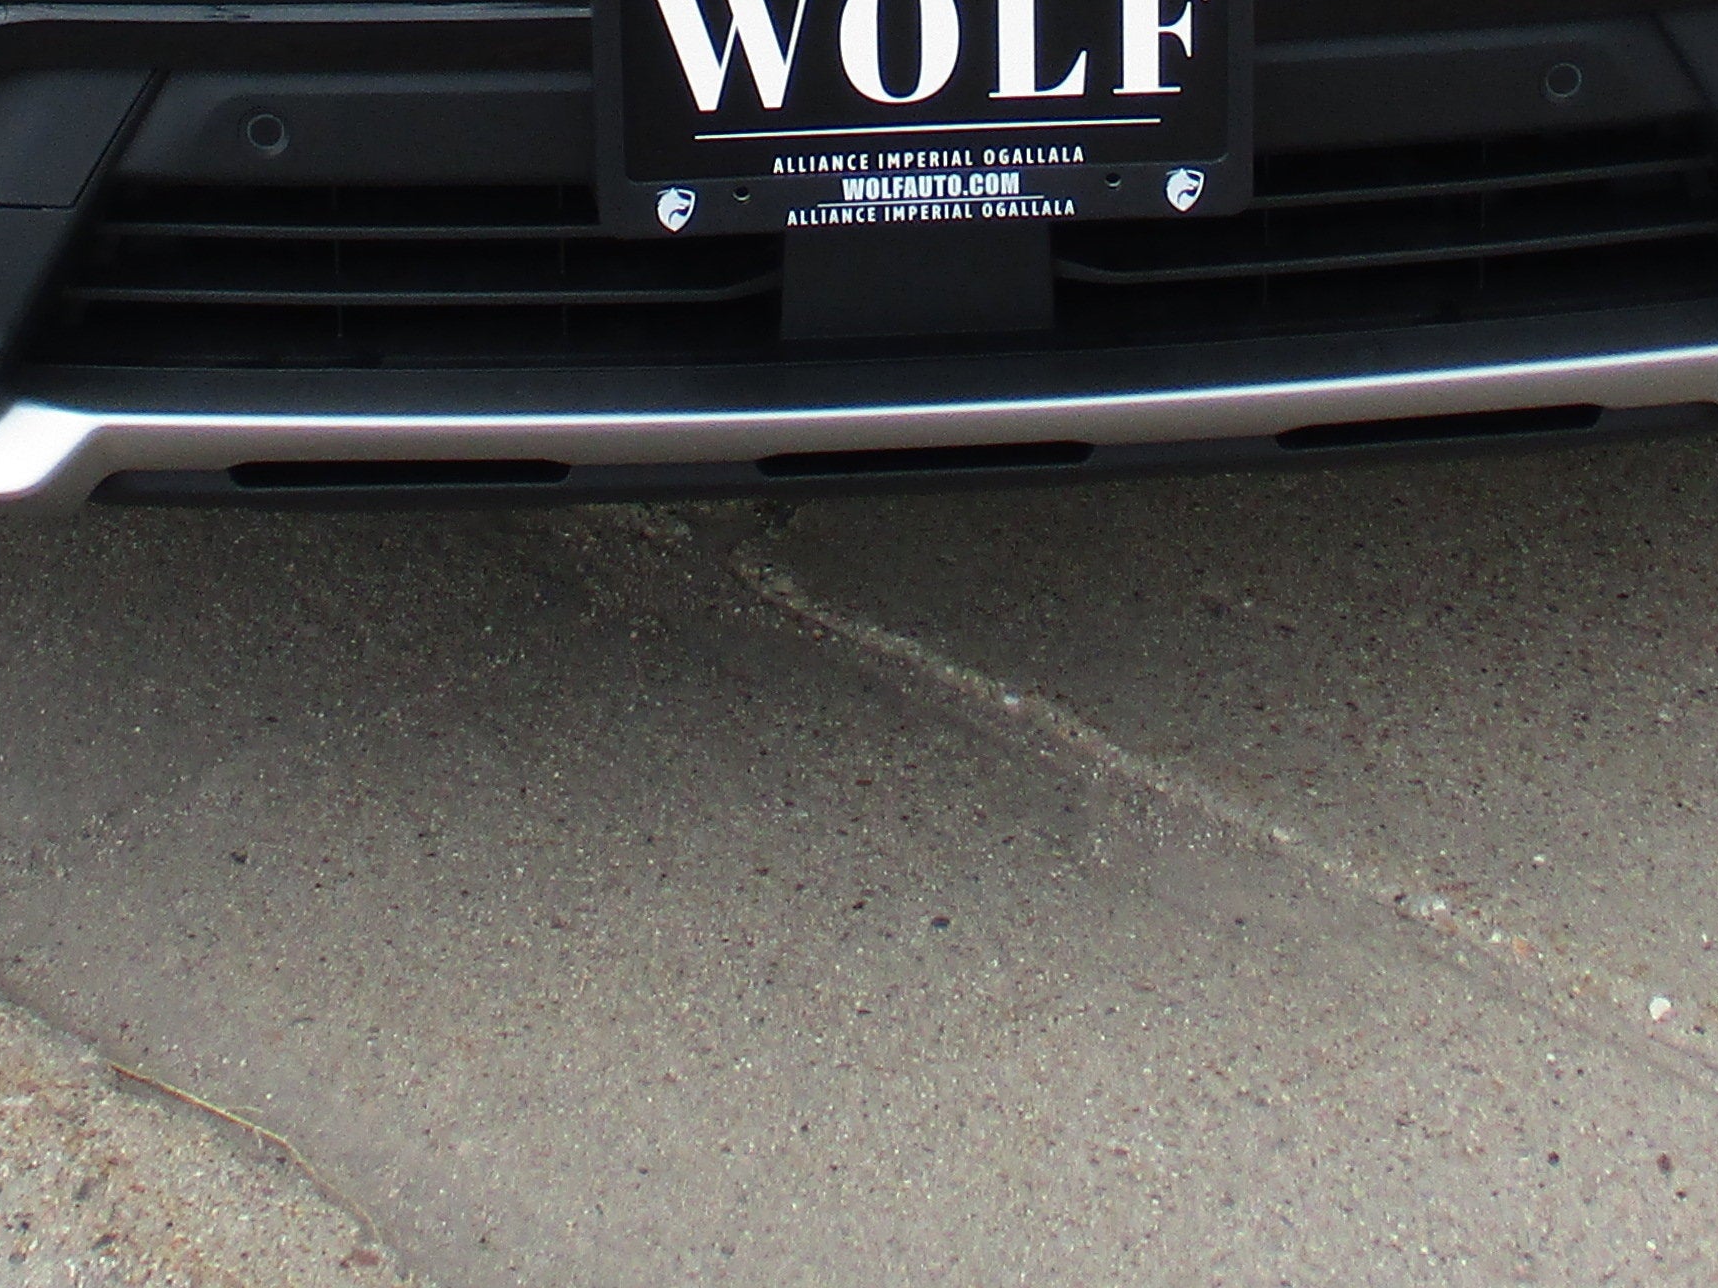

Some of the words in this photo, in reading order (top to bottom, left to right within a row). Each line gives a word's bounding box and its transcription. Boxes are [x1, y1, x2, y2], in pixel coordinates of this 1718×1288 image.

[772, 152, 870, 174] ALLIANCE
[878, 149, 974, 170] IMPERIAL
[983, 145, 1085, 165] OGALLALA
[841, 171, 1021, 201] WOLFAUTO.COM
[786, 206, 877, 226] ALLIANCE
[883, 202, 974, 222] IMPERIAL
[982, 198, 1076, 218] OGALLALA
